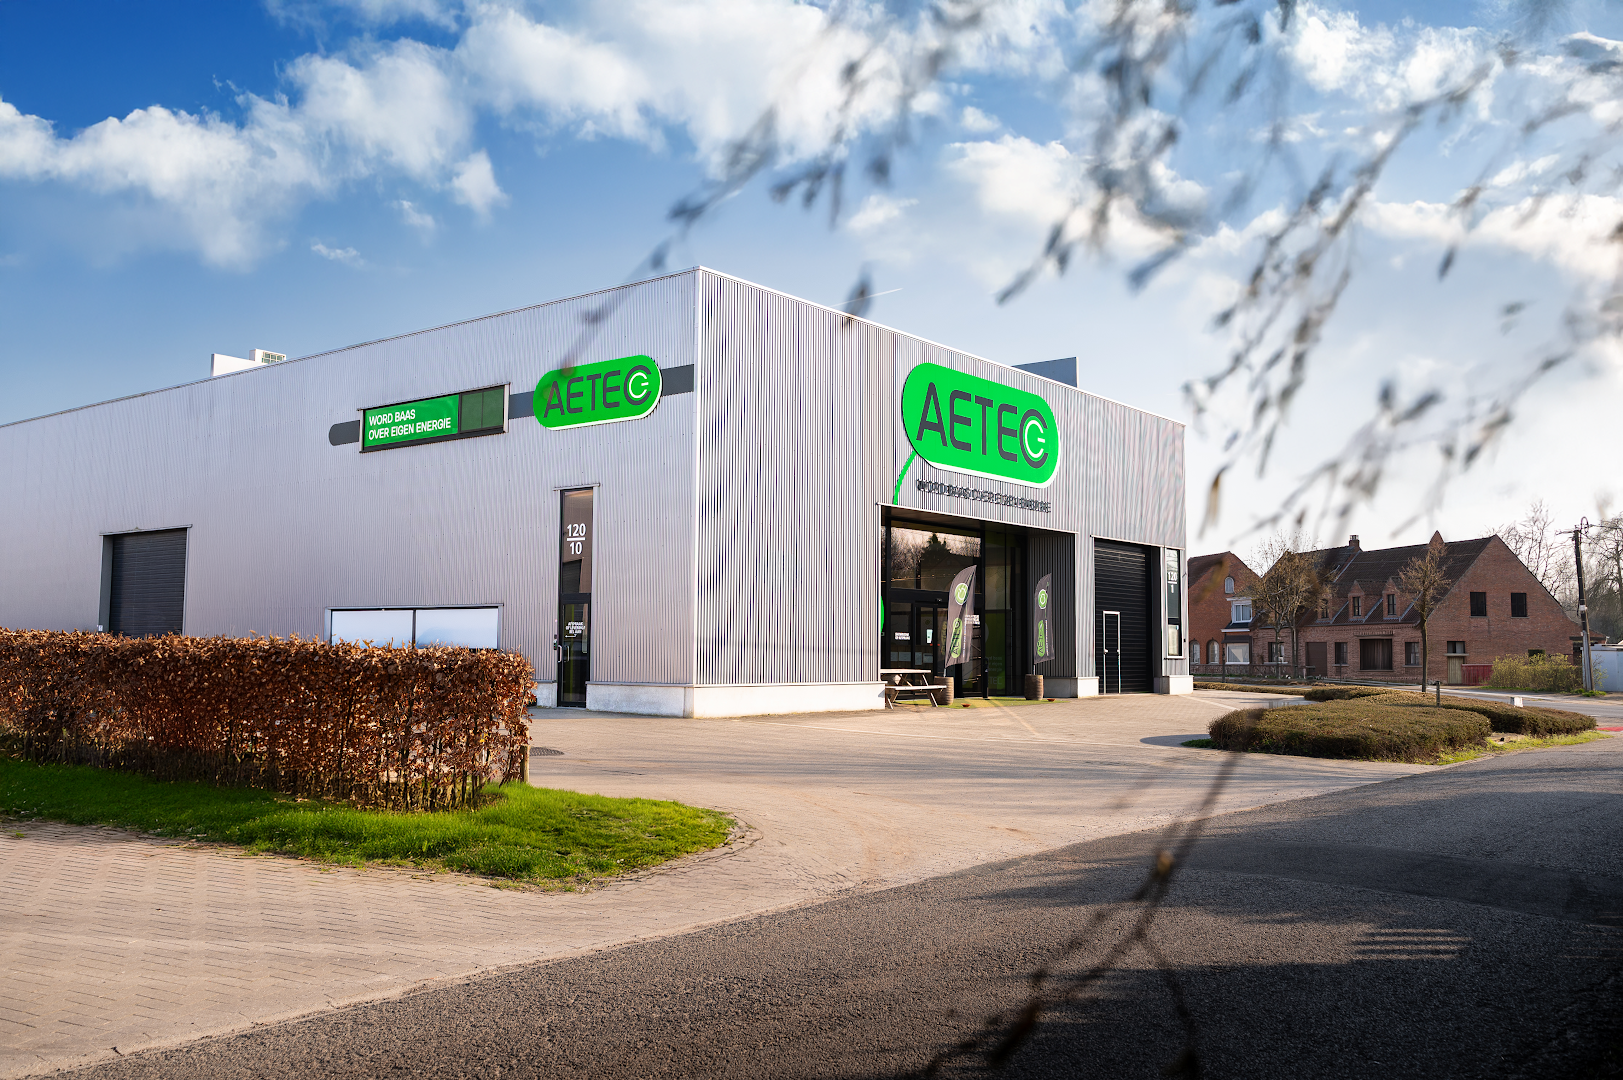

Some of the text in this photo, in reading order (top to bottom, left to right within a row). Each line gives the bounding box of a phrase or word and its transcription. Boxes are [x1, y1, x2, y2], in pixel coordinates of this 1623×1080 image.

[543, 364, 652, 419] AETEC
[369, 409, 416, 426] WORD BAAS
[915, 381, 1049, 469] AETEC
[368, 417, 452, 440] OVER EIGEN ENERGIE
[567, 523, 586, 537] 120
[569, 541, 583, 555] 10
[1168, 571, 1178, 581] 120
[1171, 584, 1175, 594] 1
